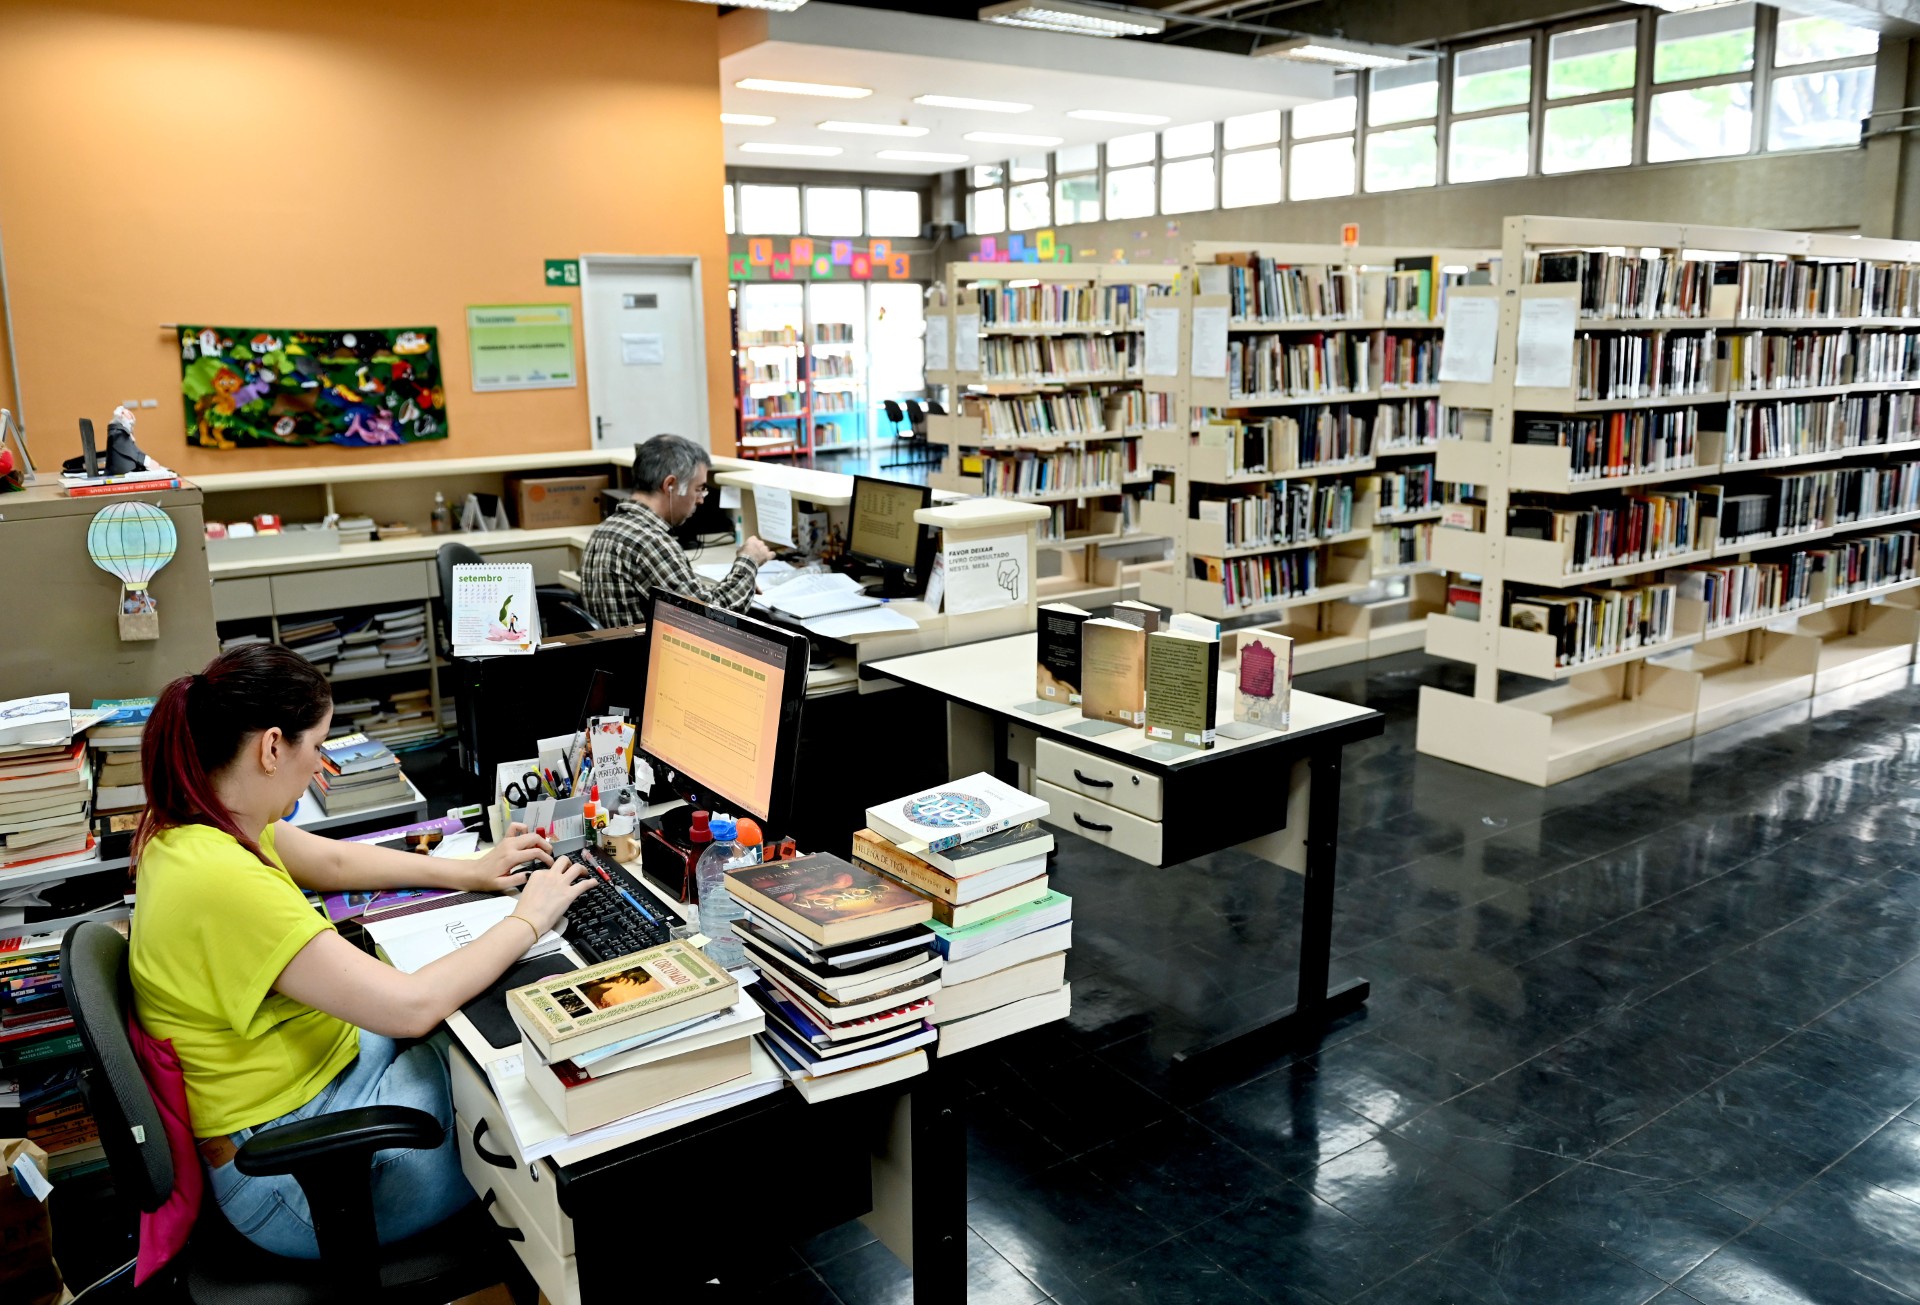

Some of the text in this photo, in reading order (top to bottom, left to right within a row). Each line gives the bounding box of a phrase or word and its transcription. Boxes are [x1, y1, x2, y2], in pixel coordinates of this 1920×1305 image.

[733, 259, 746, 275] K
[755, 244, 764, 261] L
[774, 259, 790, 274] M
[795, 244, 809, 260] N
[815, 256, 830, 275] O
[836, 243, 849, 261] P
[875, 244, 885, 260] R
[895, 258, 905, 275] S
[969, 552, 1010, 562] CONSULTADO
[970, 546, 993, 554] DEIXAR
[972, 562, 990, 570] MESA
[458, 574, 503, 582] setembro
[854, 842, 881, 862] HELENA
[881, 854, 891, 866] DE
[793, 884, 890, 909] COROA
[652, 958, 690, 985] CORCOVADO
